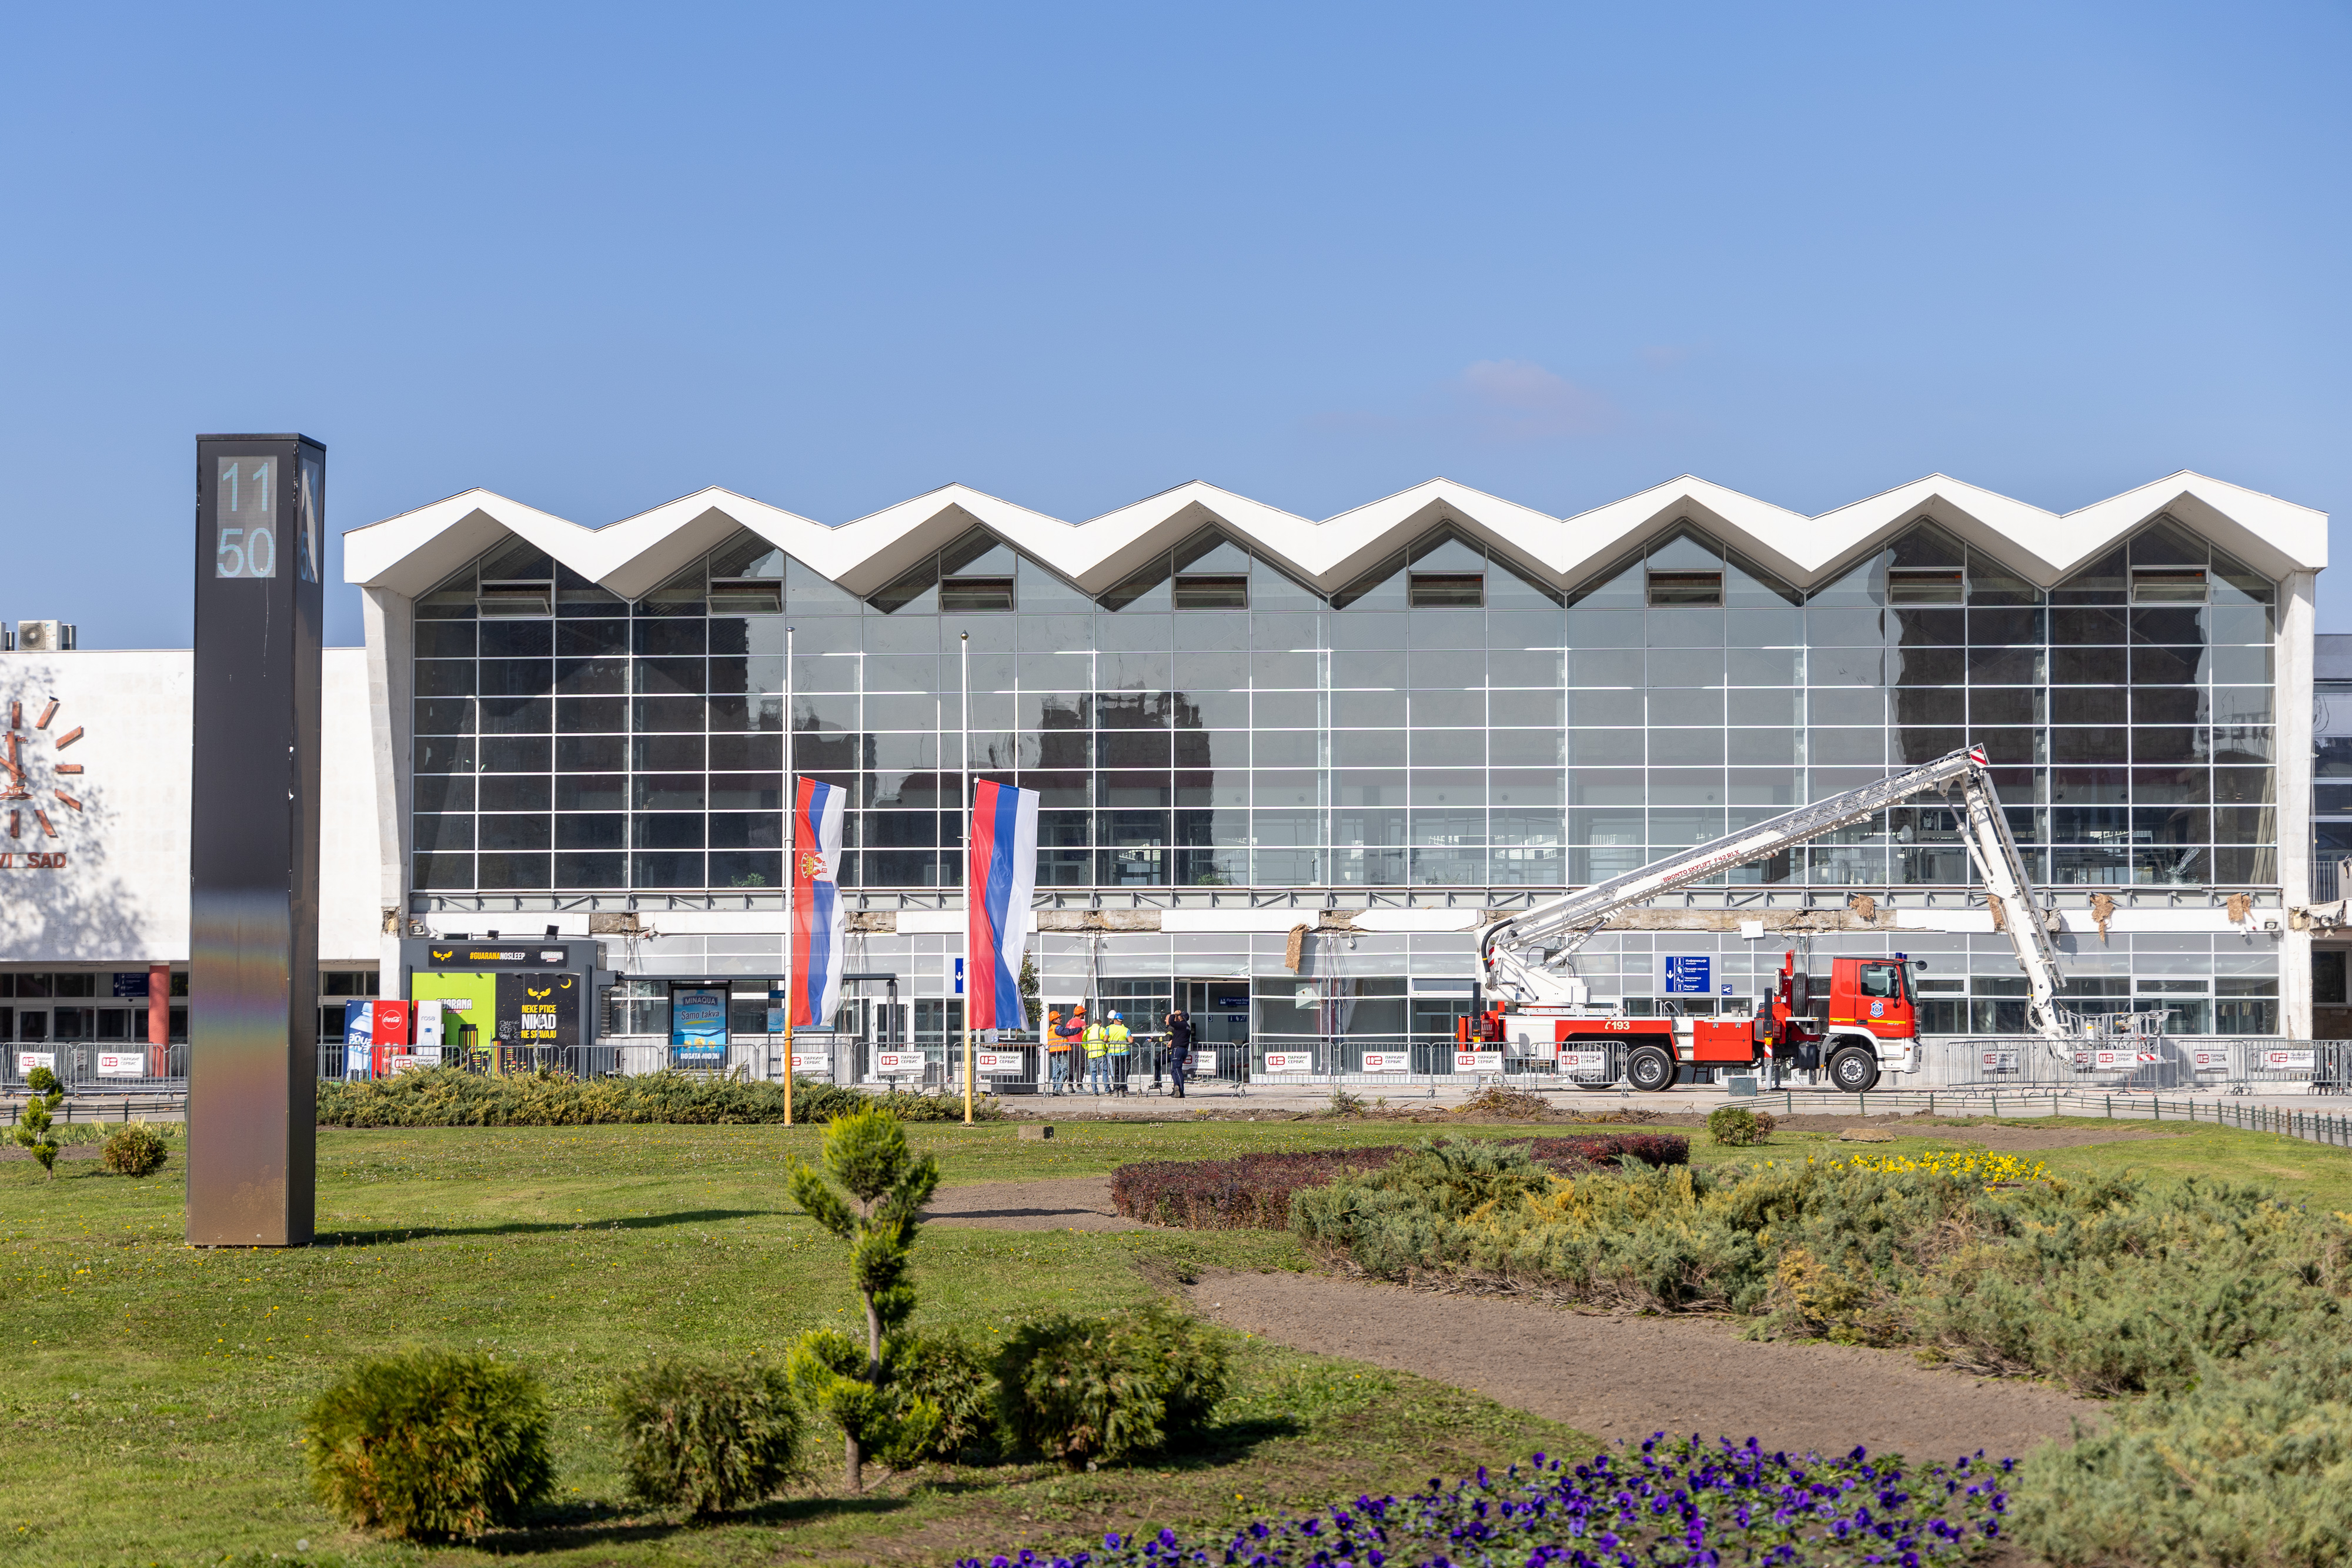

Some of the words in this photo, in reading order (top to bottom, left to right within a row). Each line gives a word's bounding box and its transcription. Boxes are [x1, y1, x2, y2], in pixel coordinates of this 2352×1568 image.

[222, 462, 268, 511] 11
[217, 527, 275, 578] 50
[27, 852, 66, 868] SAD
[1662, 870, 1688, 882] BRONTO
[1688, 860, 1711, 873] SKYLIFT
[469, 952, 525, 960] #GUARANANOSLEEP
[436, 998, 472, 1009] UARANA
[684, 997, 716, 1005] MINAQUA
[521, 1004, 538, 1014] NEKE
[539, 1004, 557, 1014] PTICE
[681, 1011, 700, 1020] Samo
[701, 1010, 720, 1018] takva
[521, 1014, 556, 1029] NIKAD
[1611, 1021, 1630, 1030] 193
[520, 1030, 530, 1039] NE
